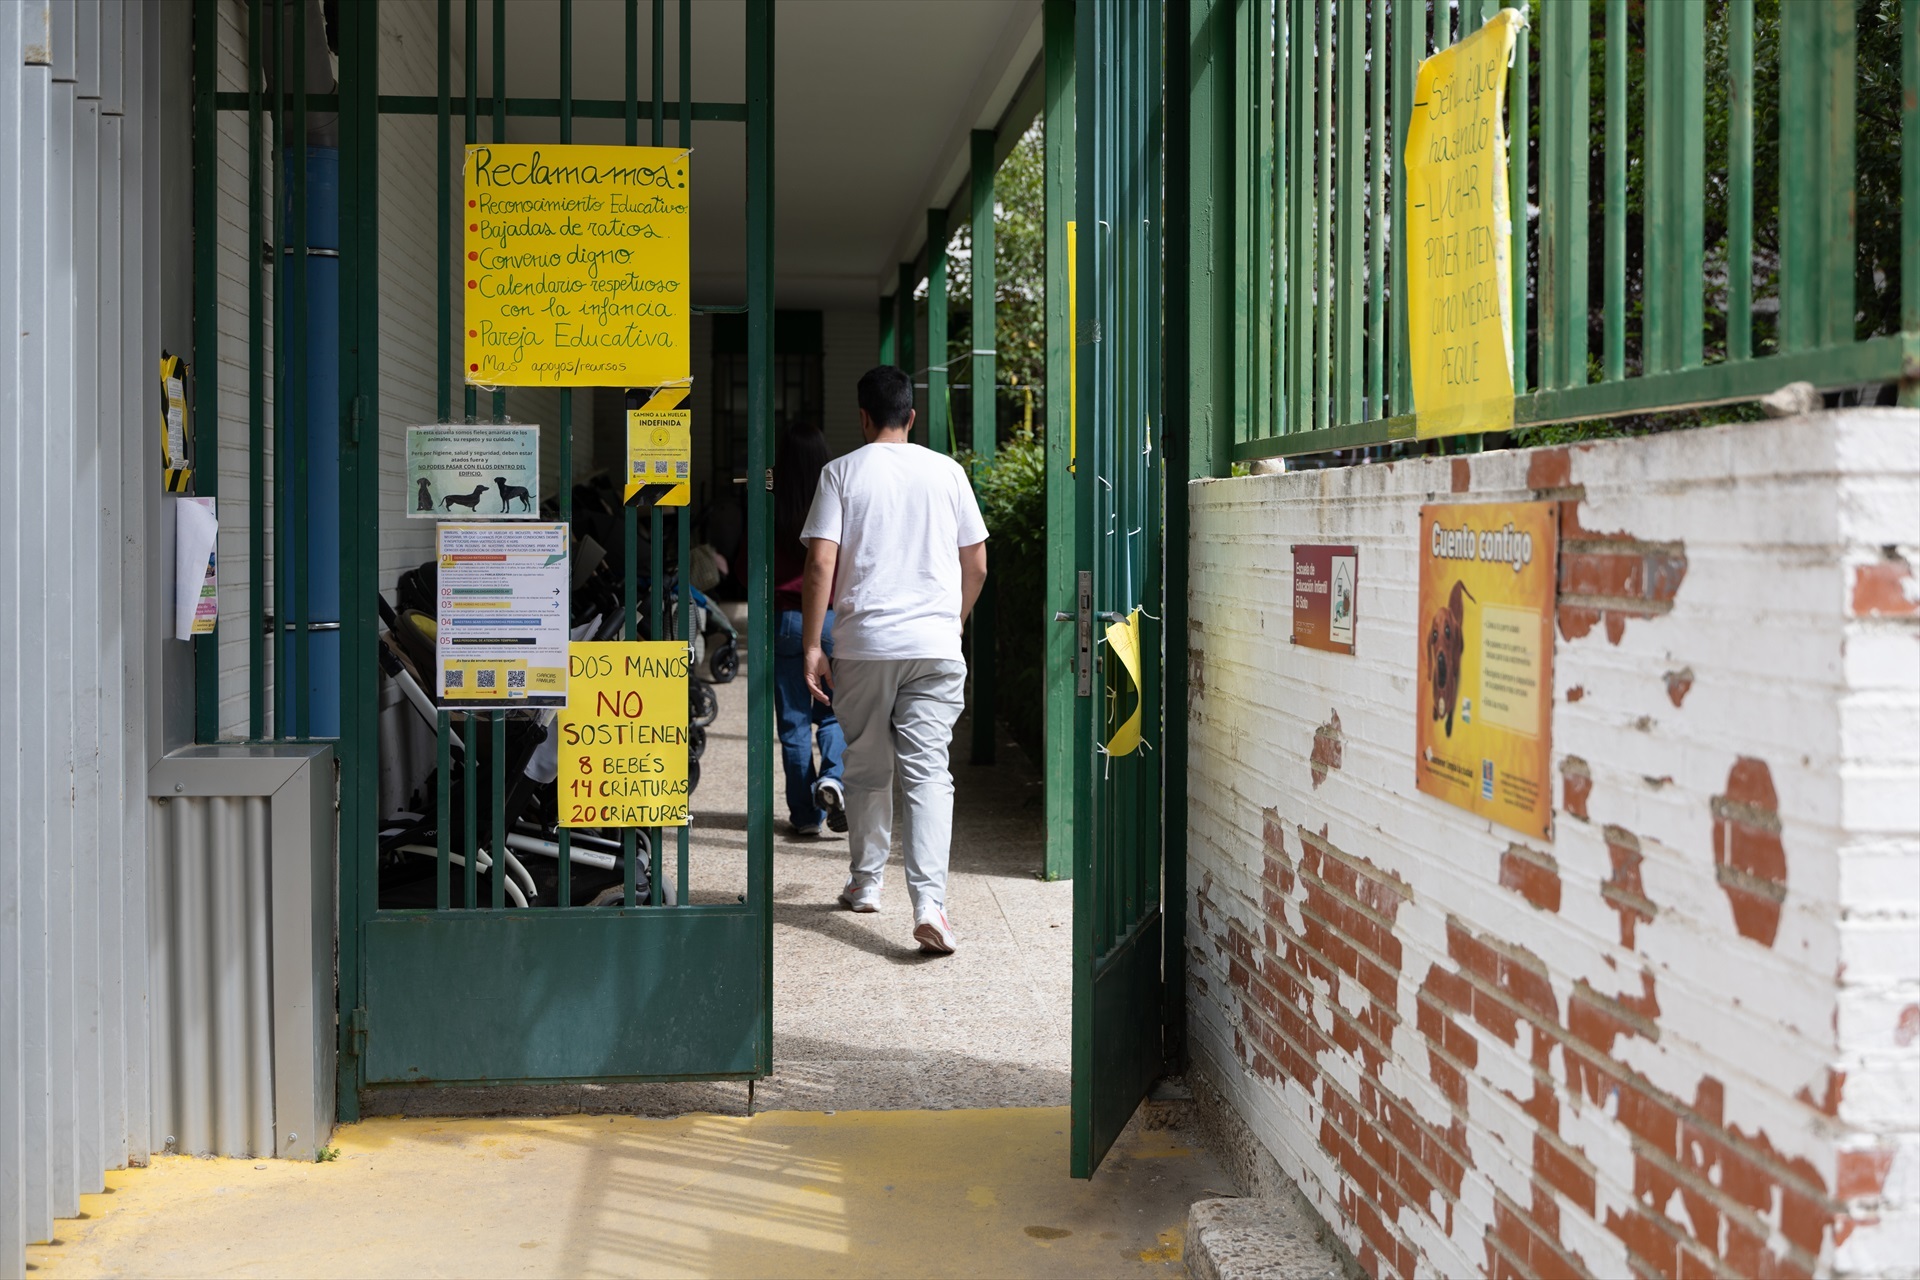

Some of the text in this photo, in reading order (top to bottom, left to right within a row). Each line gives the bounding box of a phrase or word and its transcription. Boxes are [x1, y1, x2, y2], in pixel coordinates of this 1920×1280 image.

[475, 148, 686, 188] Reclamamos:
[479, 193, 605, 214] Reconocimiento
[480, 219, 556, 248] Bajadas
[560, 216, 583, 236] de
[479, 247, 561, 270] Convenio
[479, 273, 680, 300] Calendario respetuoso
[501, 304, 534, 317] con
[541, 297, 571, 317] la
[480, 320, 544, 363] Pareja
[531, 357, 626, 382] apoyos/recursos
[639, 419, 681, 427] INDEFINIDA
[1432, 521, 1532, 573] Cuento contigo
[1296, 562, 1315, 576] Escuela de
[1296, 578, 1314, 592] Educación
[1314, 580, 1328, 594] Infantil
[1300, 596, 1308, 609] Soto
[569, 655, 688, 679] DOS MANOS
[597, 690, 643, 718] NO
[563, 721, 688, 745] SOSTIENEN
[578, 753, 665, 775] 8 BEBÉS
[570, 777, 689, 798] 14 CRIATURAS
[571, 804, 597, 823] 20
